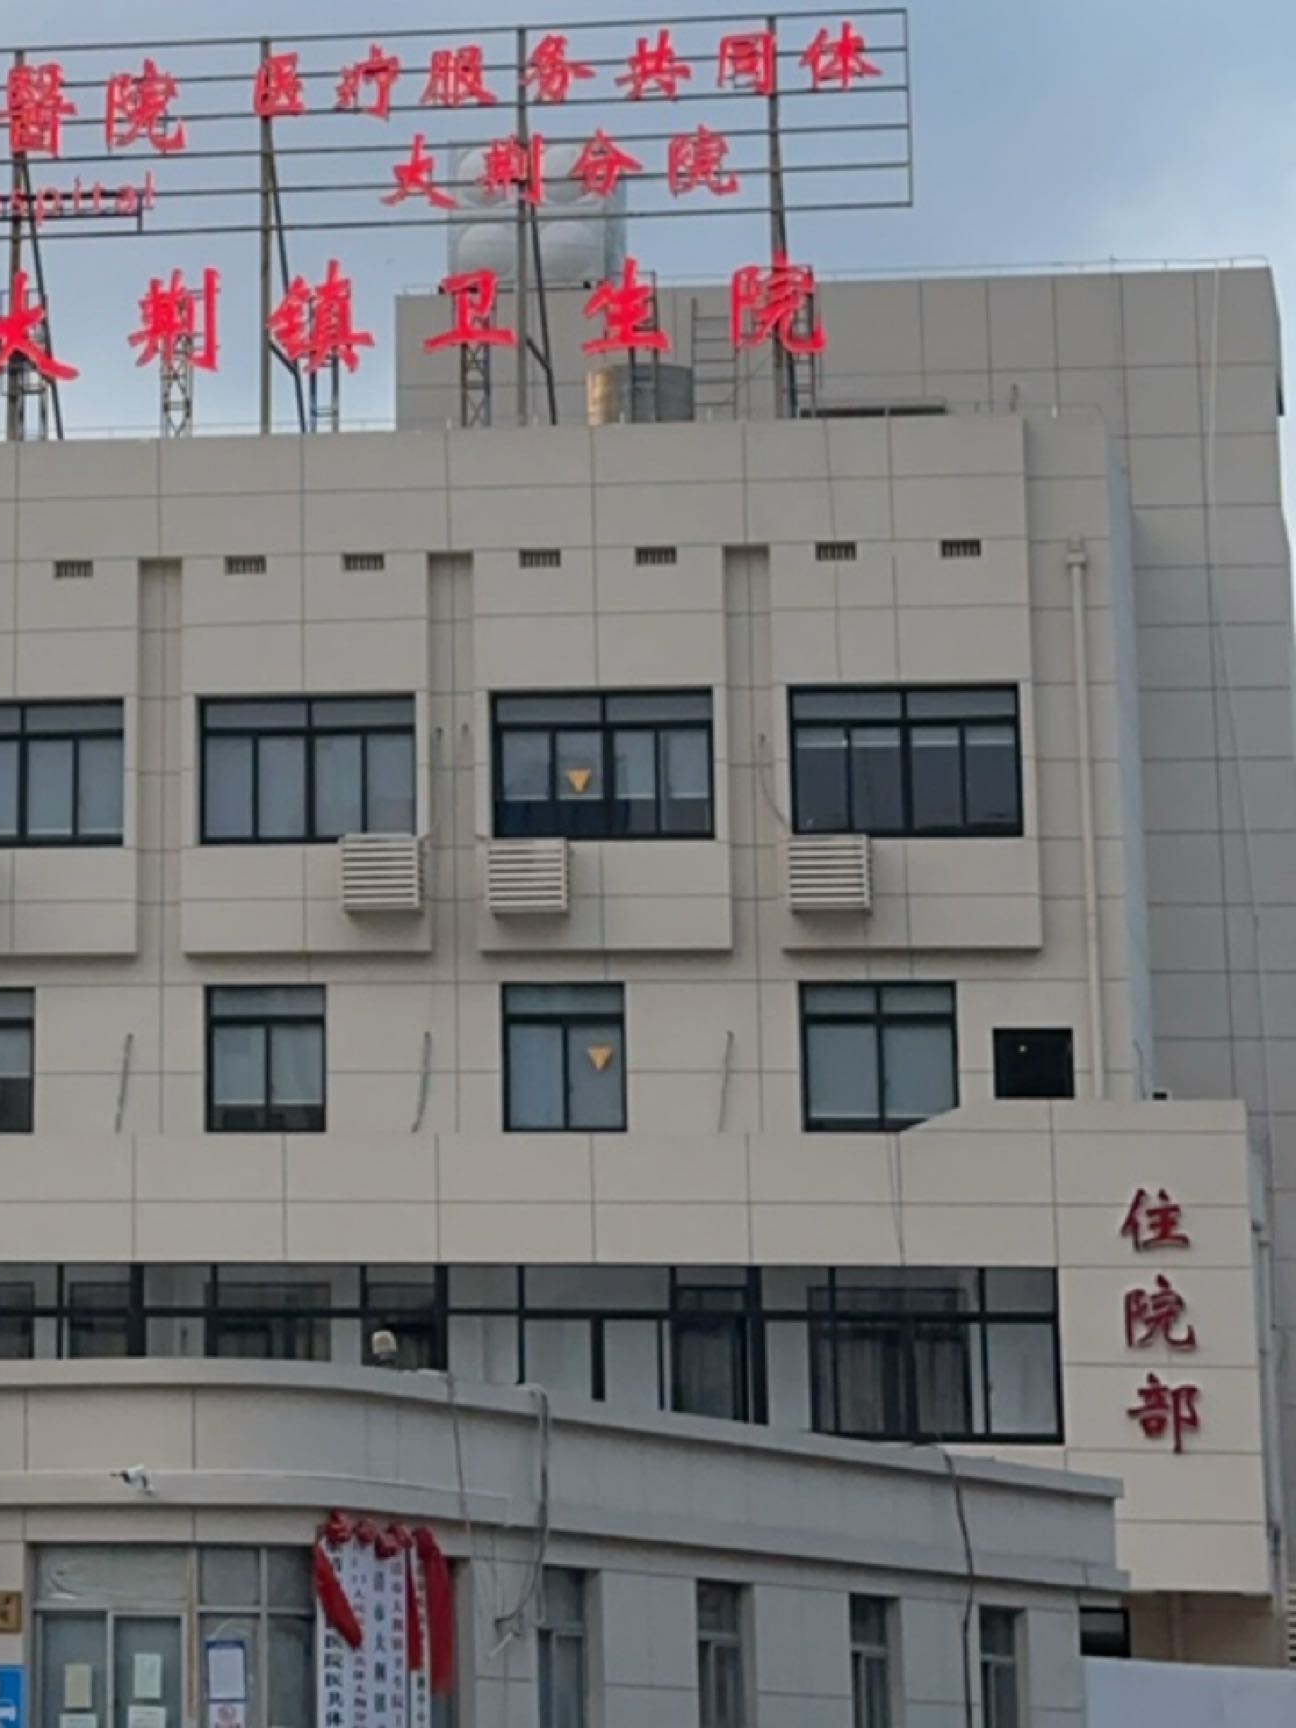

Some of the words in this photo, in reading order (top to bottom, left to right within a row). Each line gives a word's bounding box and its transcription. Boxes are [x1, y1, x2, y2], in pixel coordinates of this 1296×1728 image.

[253, 21, 882, 119] 医疗服务共同体
[380, 124, 739, 207] 大荆分院
[1120, 1188, 1200, 1454] 住院部
